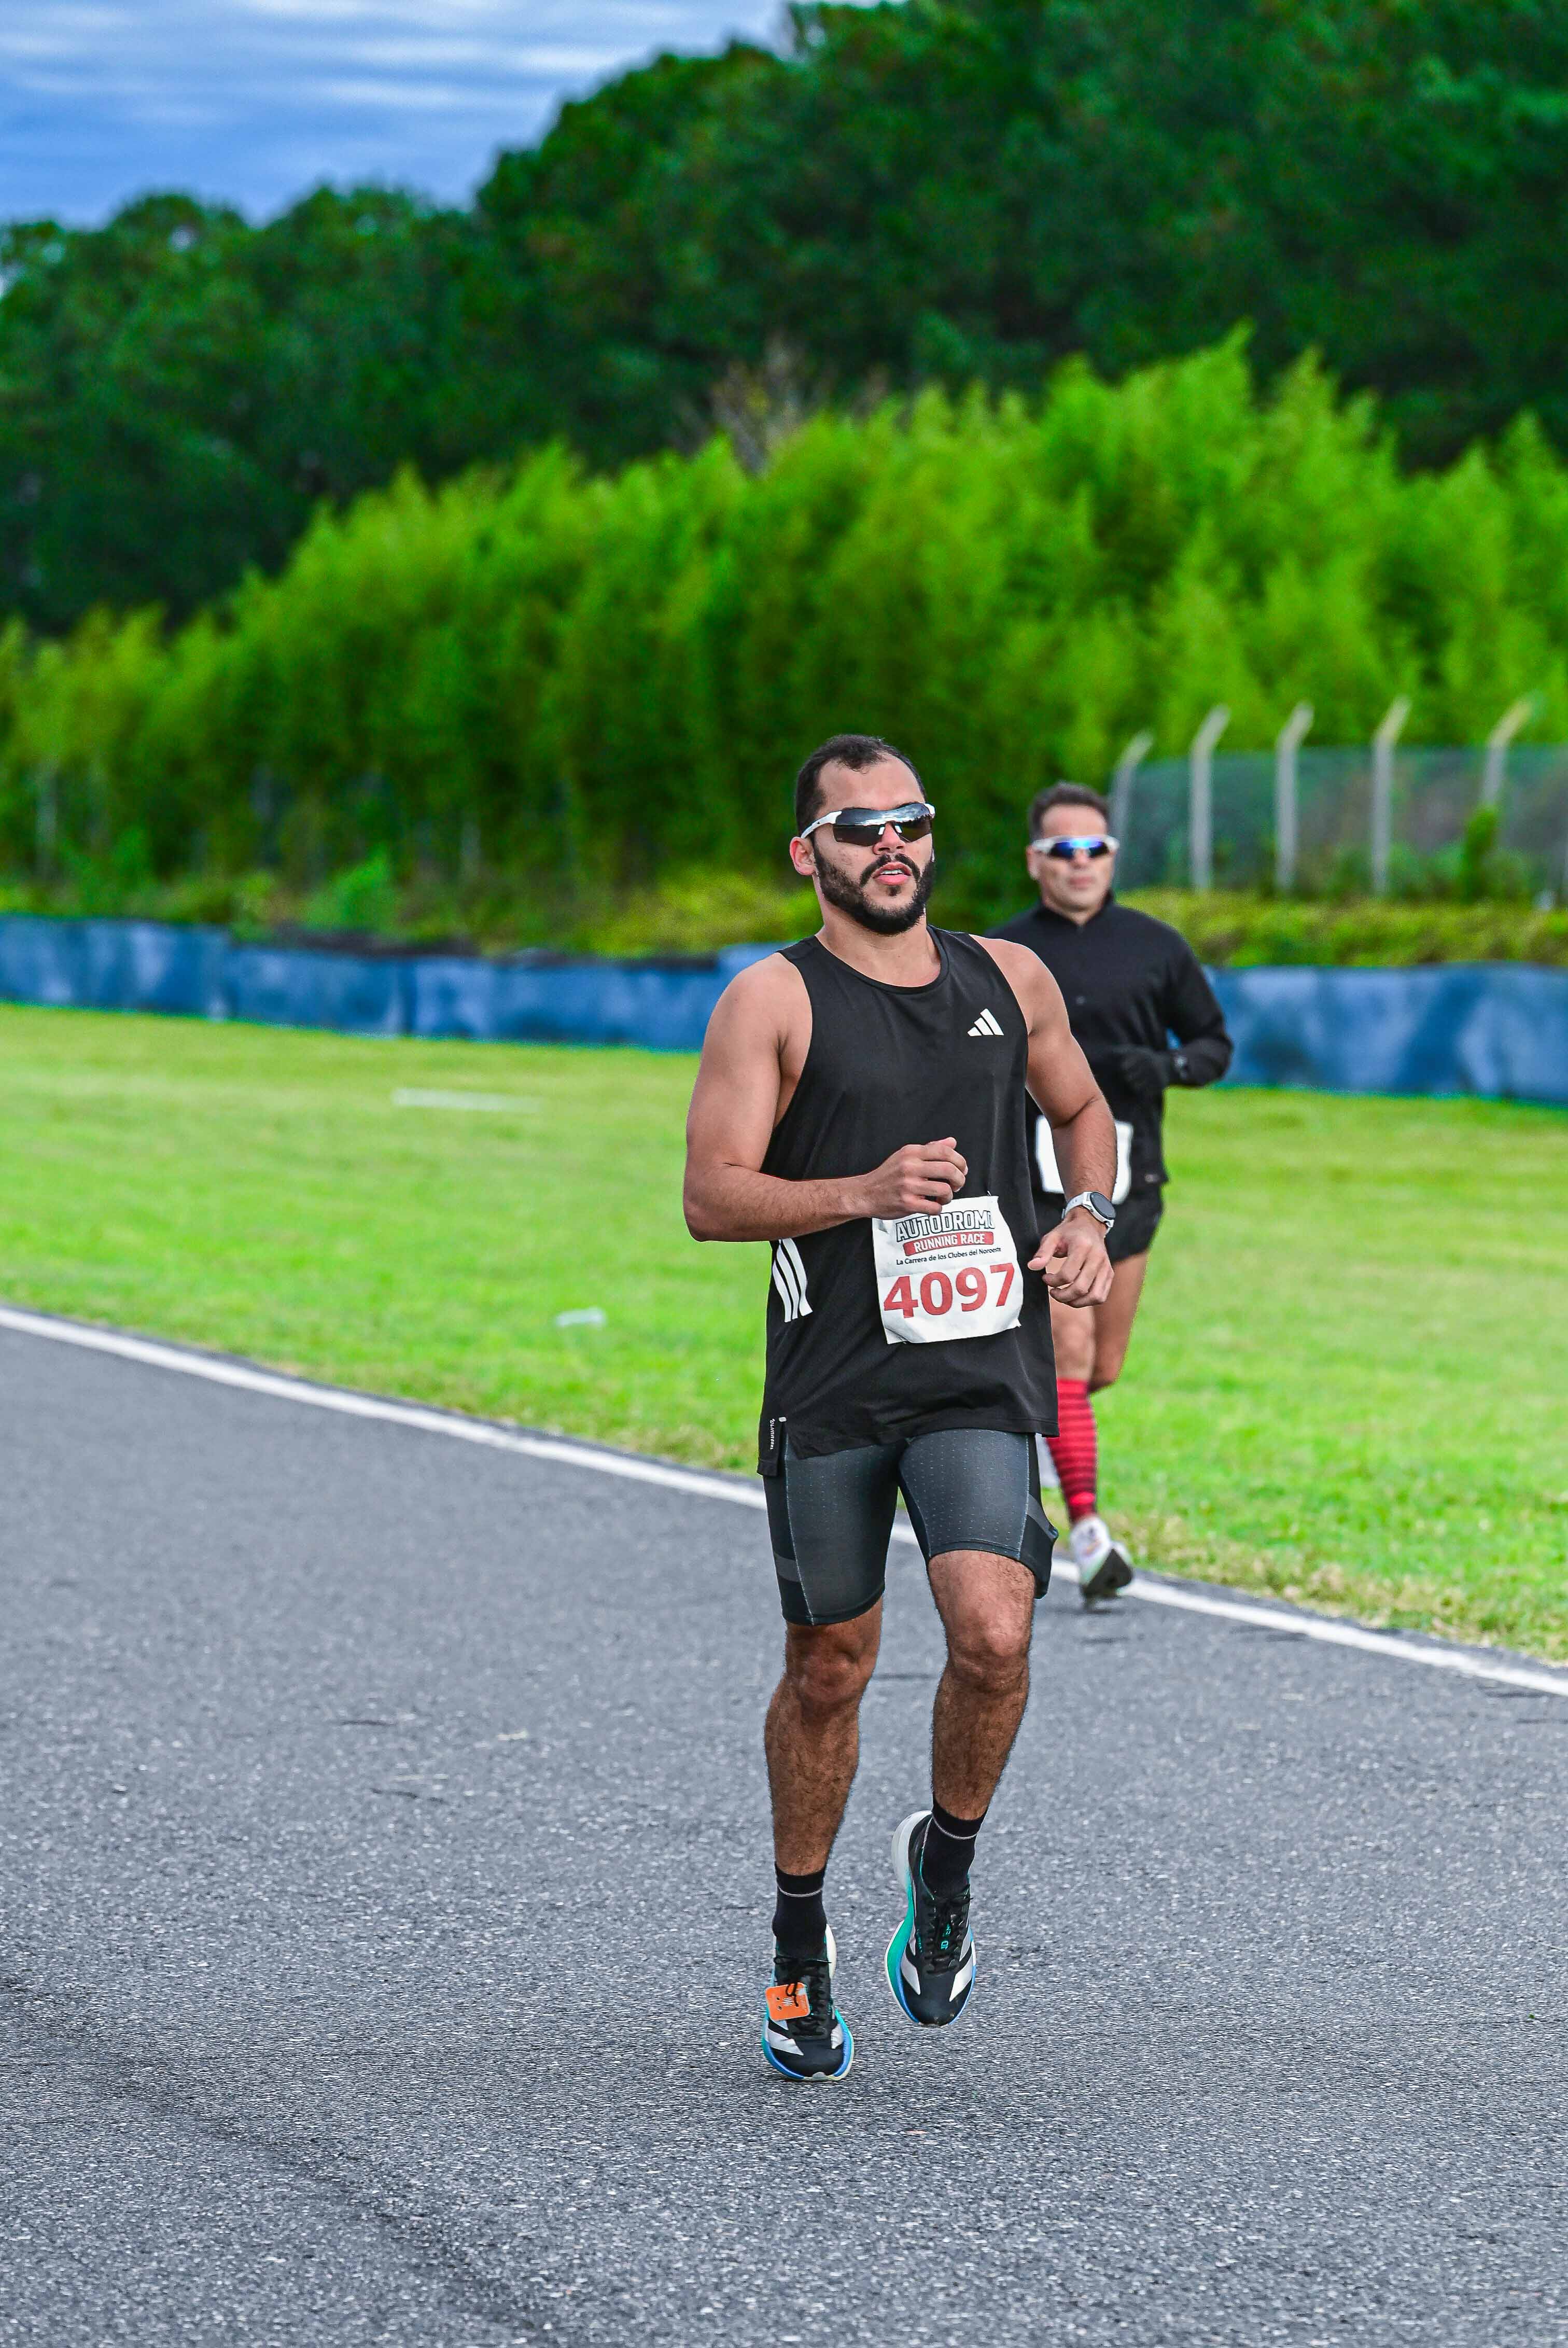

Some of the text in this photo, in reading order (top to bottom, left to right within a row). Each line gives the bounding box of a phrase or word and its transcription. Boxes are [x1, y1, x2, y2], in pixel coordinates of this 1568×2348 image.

[913, 1233, 985, 1252] RUNNING RACE
[905, 1256, 927, 1264] Carrera
[948, 1250, 968, 1259] Clubes
[884, 1263, 1015, 1319] 4097
